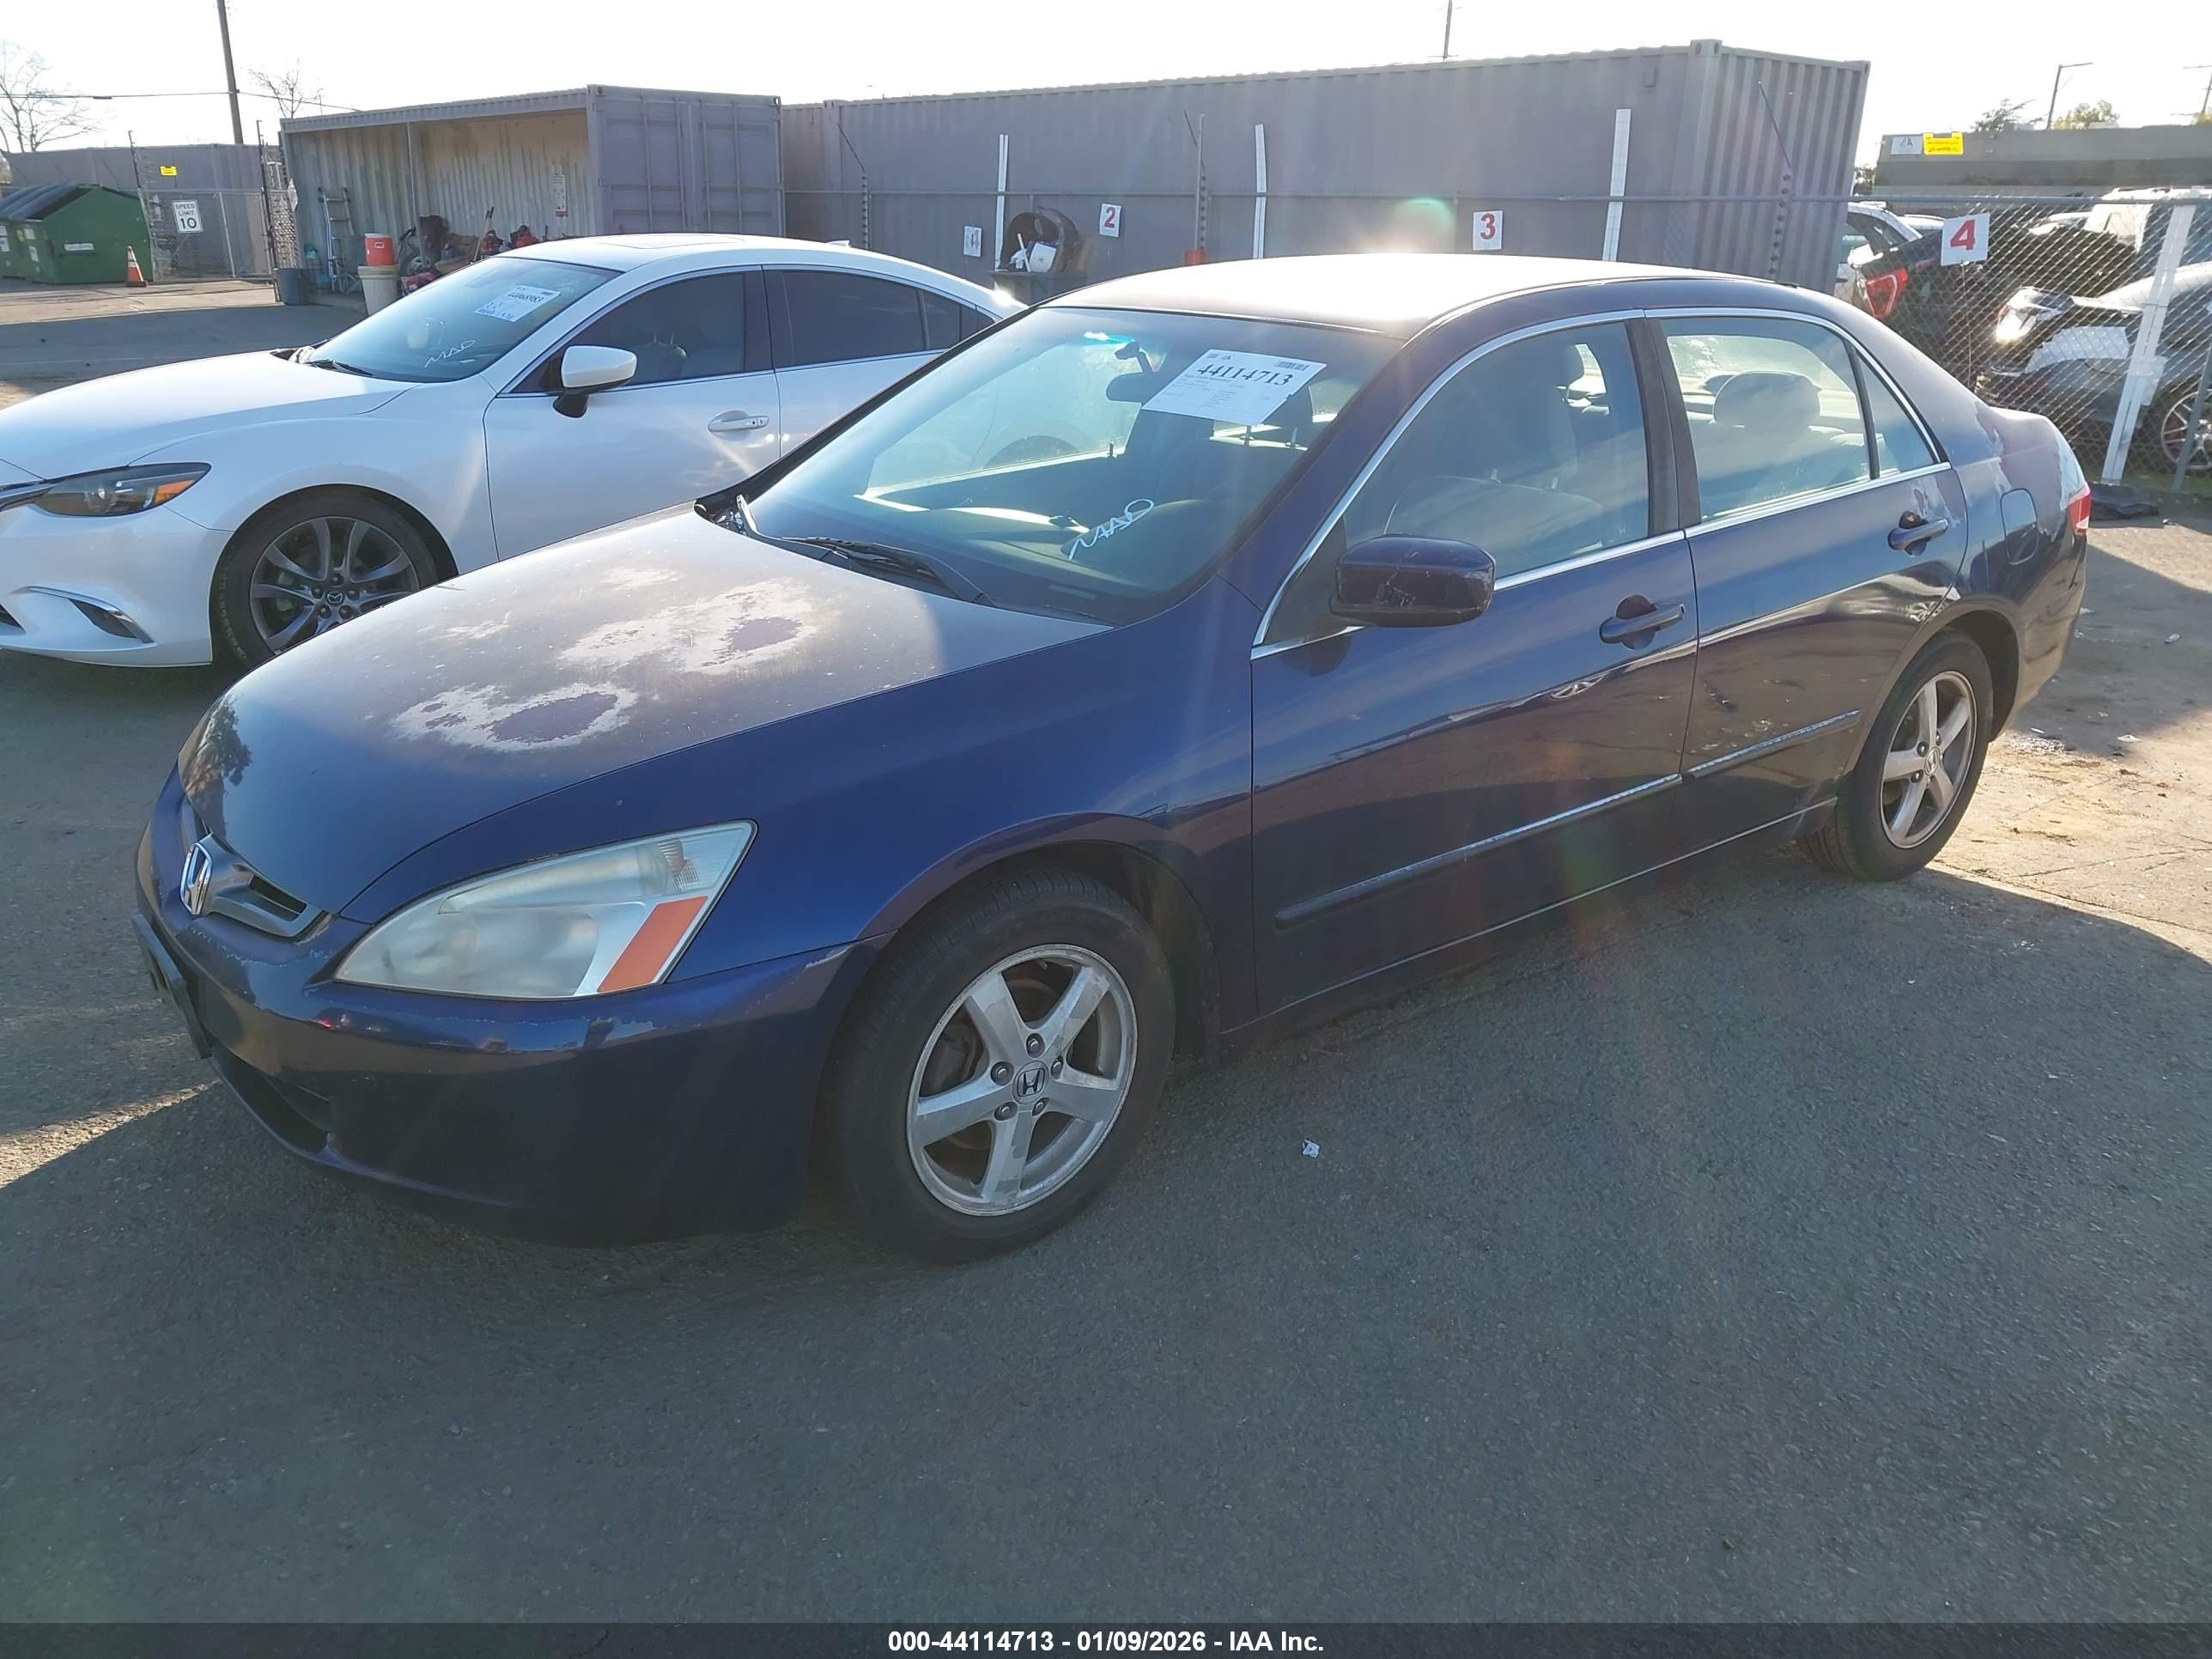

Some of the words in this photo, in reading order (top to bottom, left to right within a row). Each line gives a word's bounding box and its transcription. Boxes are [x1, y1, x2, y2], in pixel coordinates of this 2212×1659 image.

[180, 217, 197, 229] 10
[1104, 207, 1116, 228] 2
[1480, 213, 1496, 240] 3
[1950, 219, 1975, 250] 4
[1197, 363, 1293, 386] 44114713
